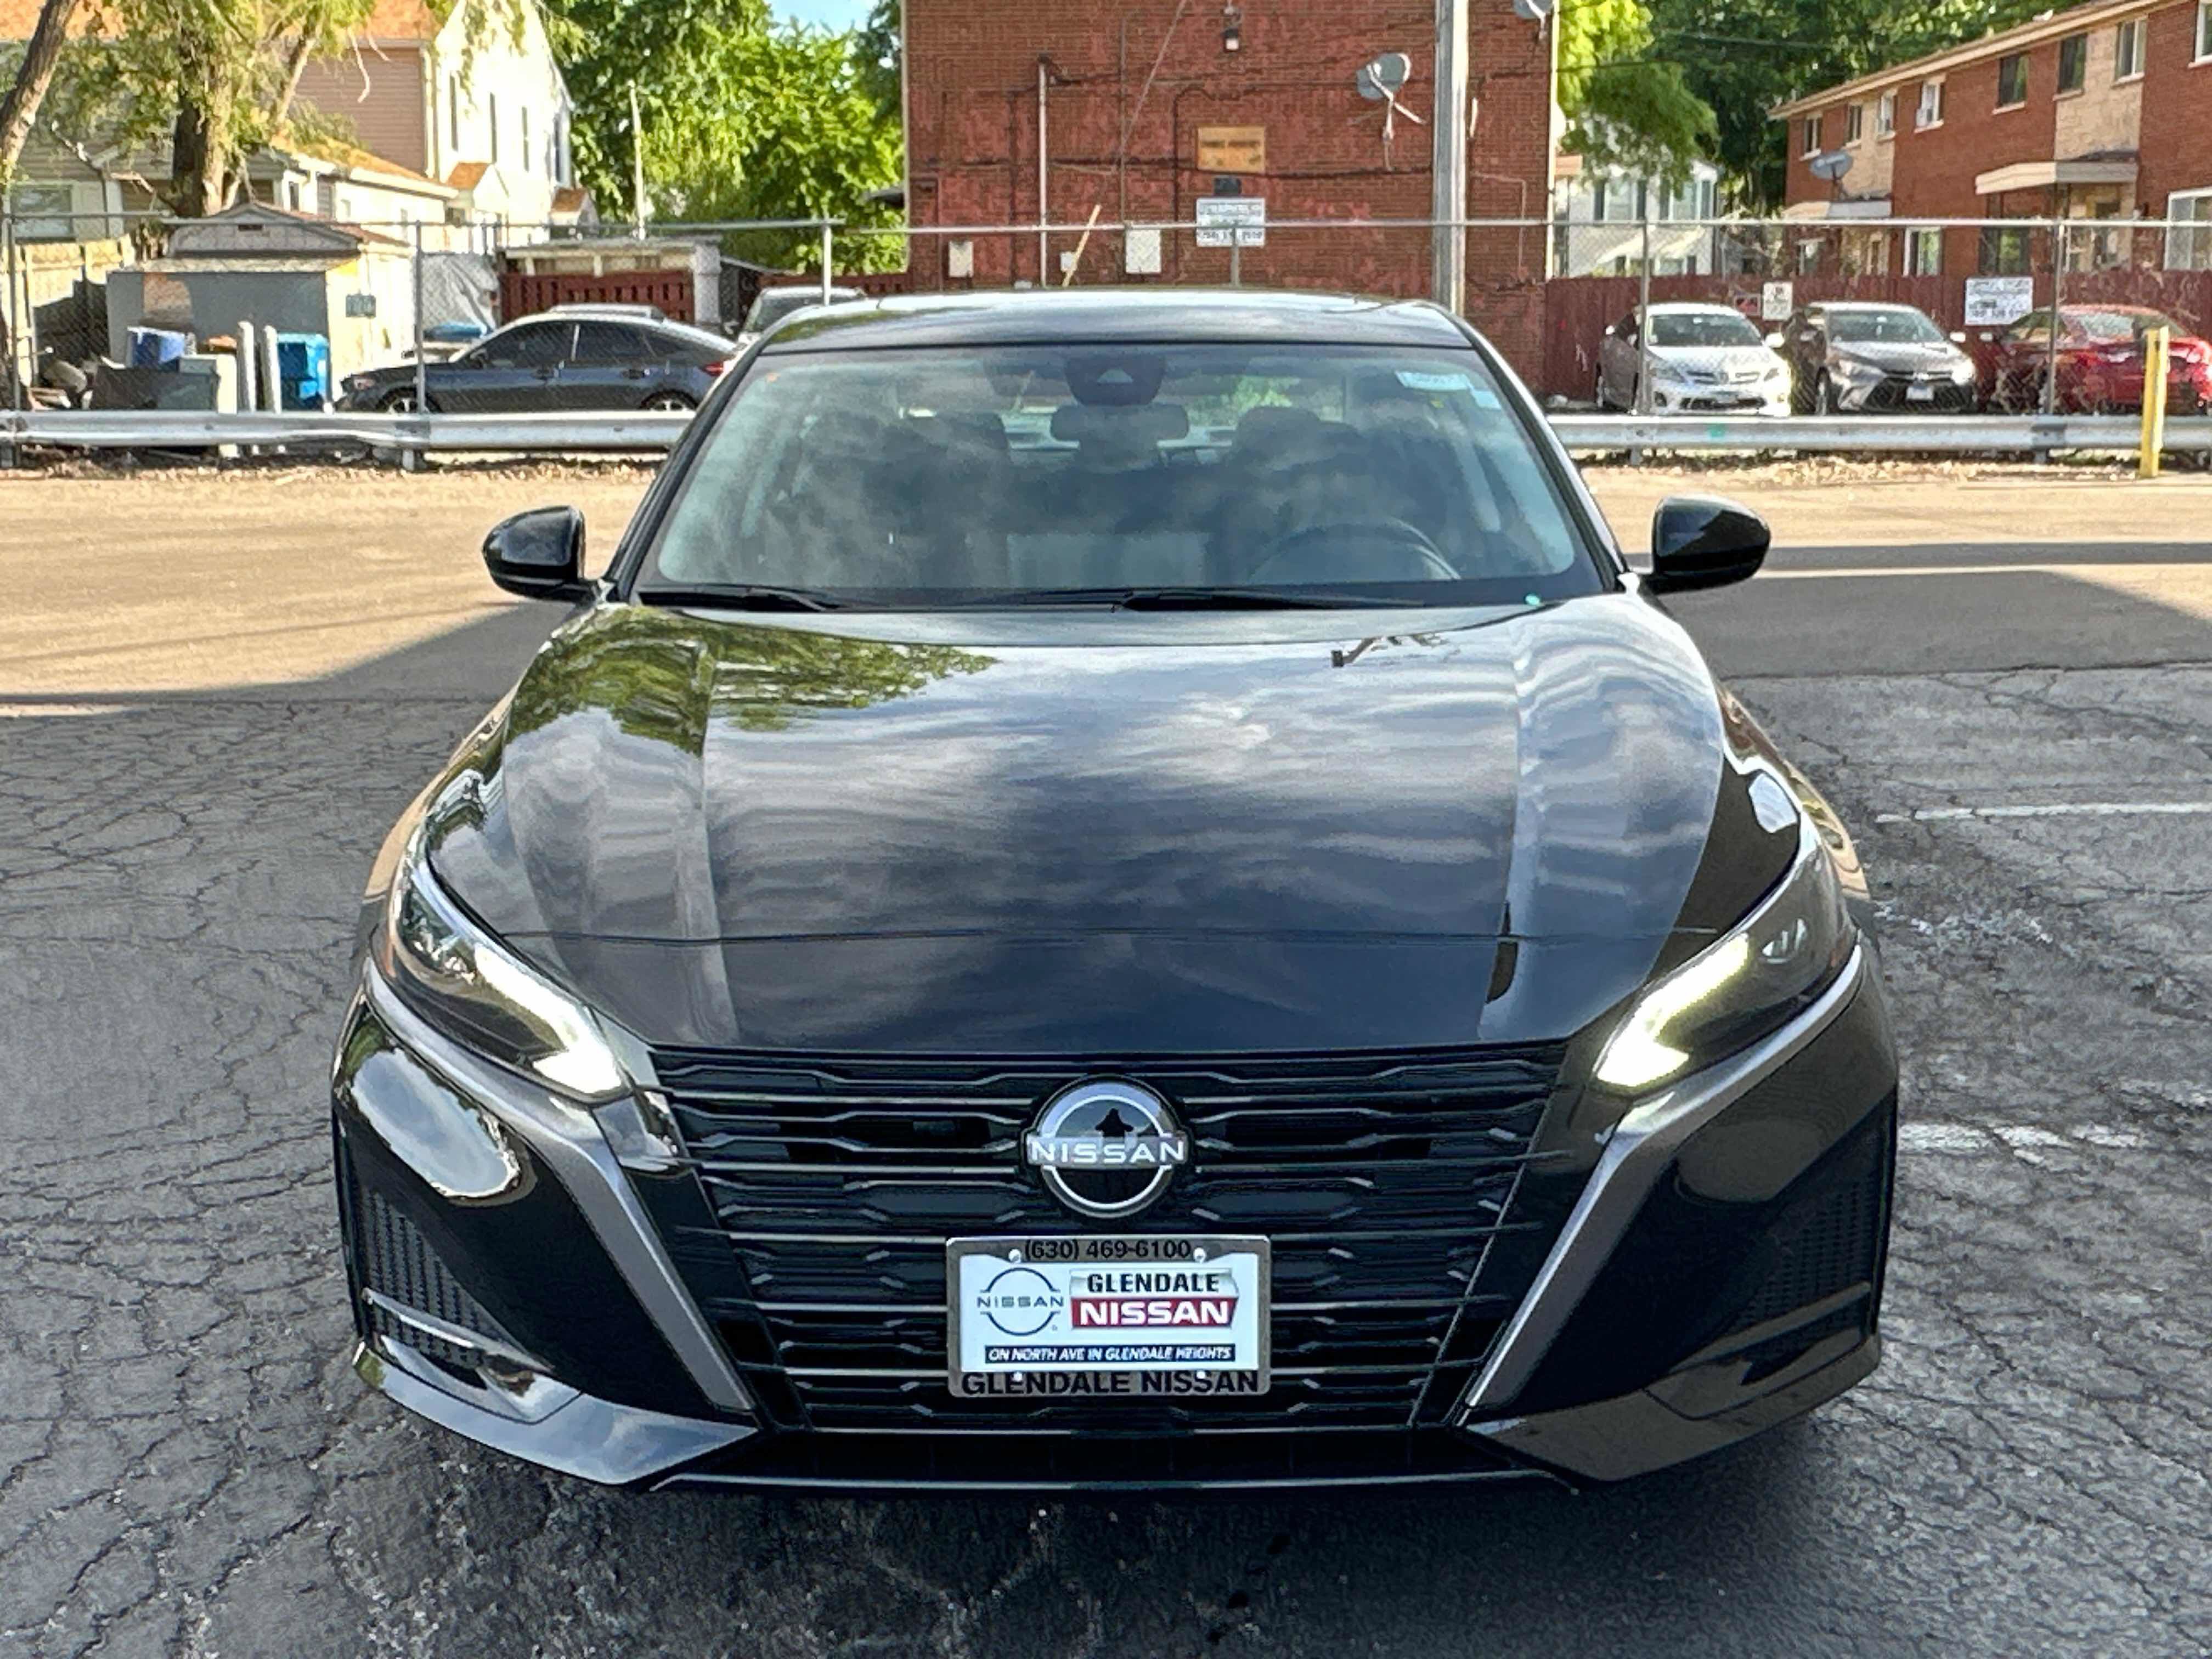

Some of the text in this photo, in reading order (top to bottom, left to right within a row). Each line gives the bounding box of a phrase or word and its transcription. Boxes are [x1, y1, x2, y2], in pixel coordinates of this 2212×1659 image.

[1031, 1139, 1185, 1164] NISSAN
[1025, 1239, 1191, 1260] (630) 469-6100
[1087, 1273, 1220, 1293] GLENDALE
[977, 1296, 1064, 1307] NISSAN
[1080, 1302, 1229, 1325] NISSAN
[989, 1347, 1232, 1361] ON NORTH AVE IN GLENDALE HEIGHTS
[962, 1370, 1258, 1394] GLENDALE NISSAN
